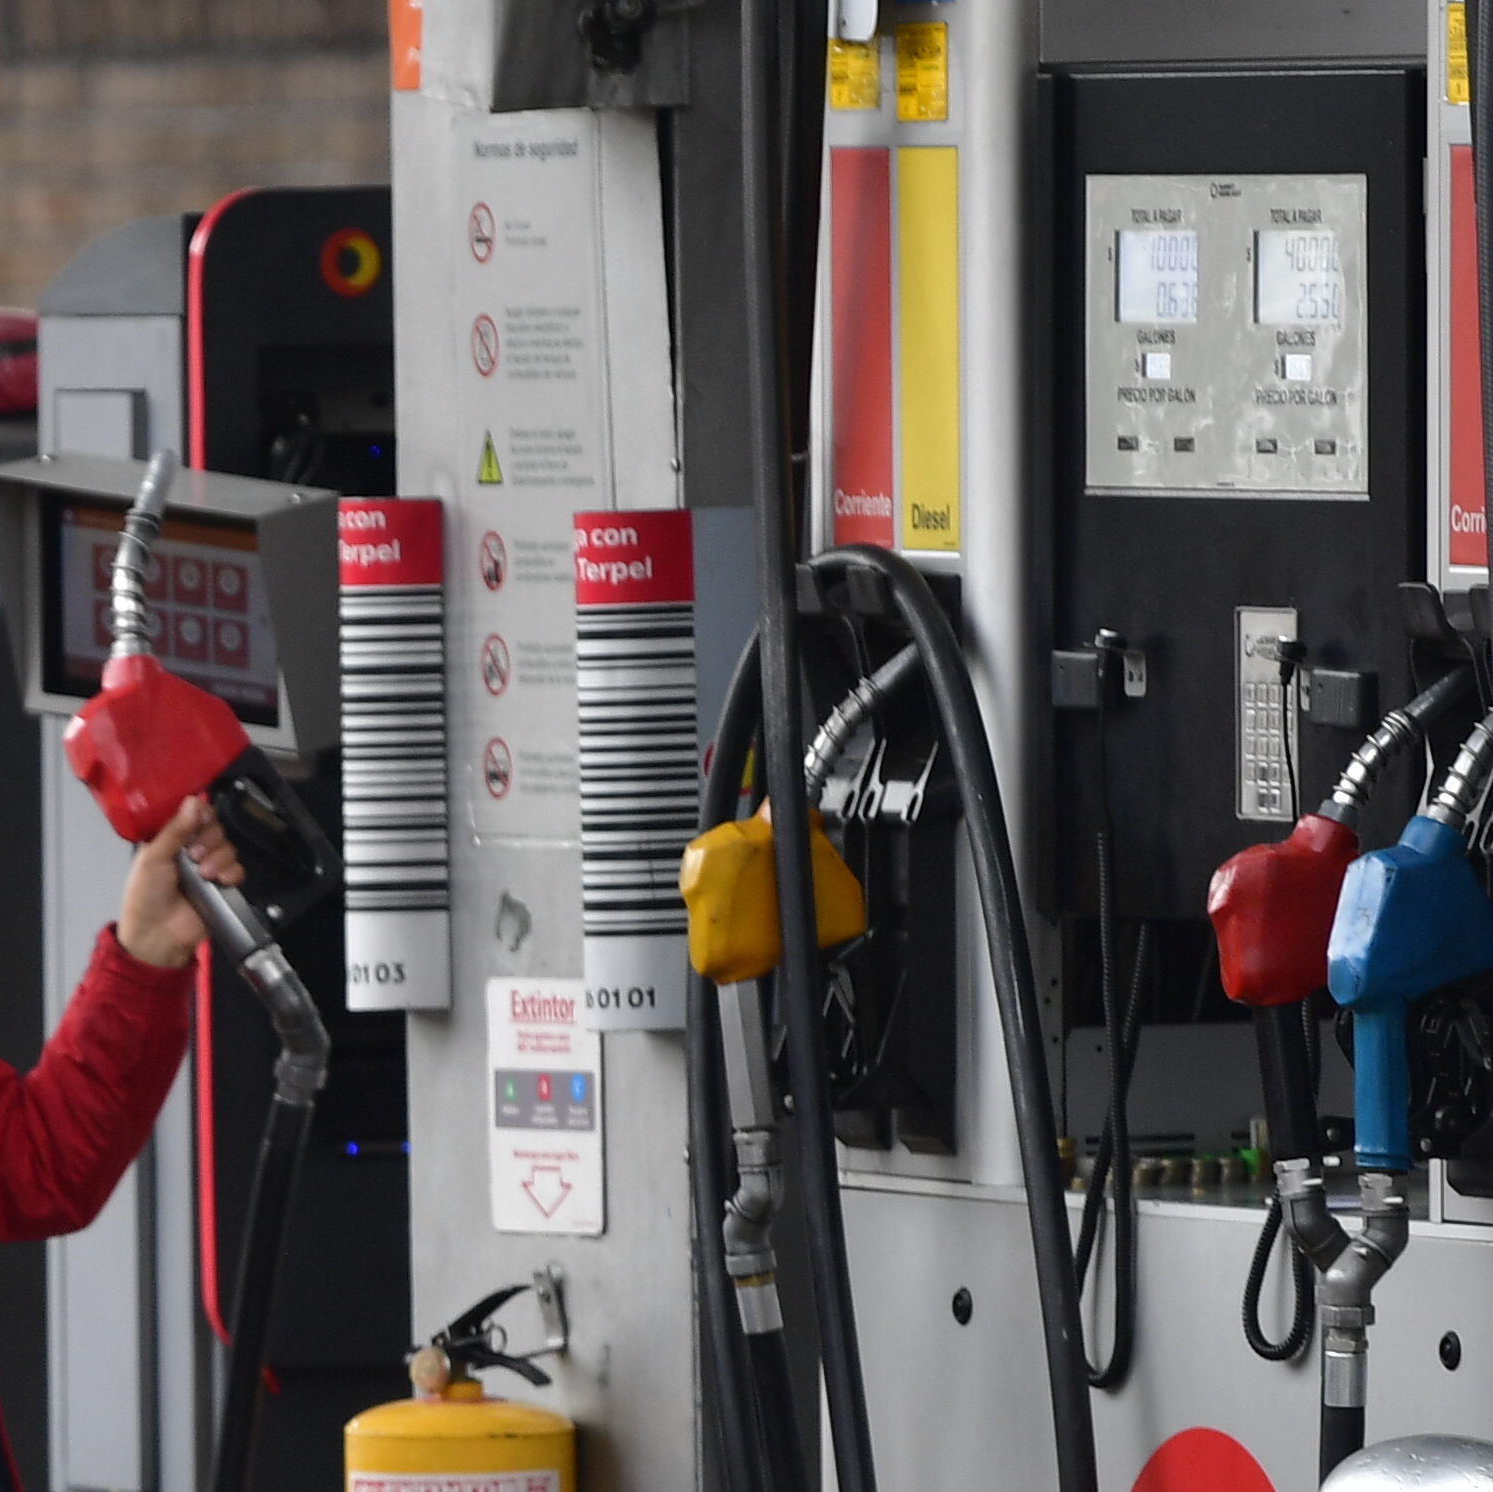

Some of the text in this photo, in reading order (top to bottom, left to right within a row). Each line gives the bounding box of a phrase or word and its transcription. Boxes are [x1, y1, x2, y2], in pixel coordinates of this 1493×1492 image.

[835, 489, 893, 517] Corriente
[912, 502, 951, 530] Diesel
[1451, 504, 1488, 534] Corri
[591, 526, 638, 548] con
[577, 554, 653, 585] Terpel
[511, 988, 576, 1020] Extintor
